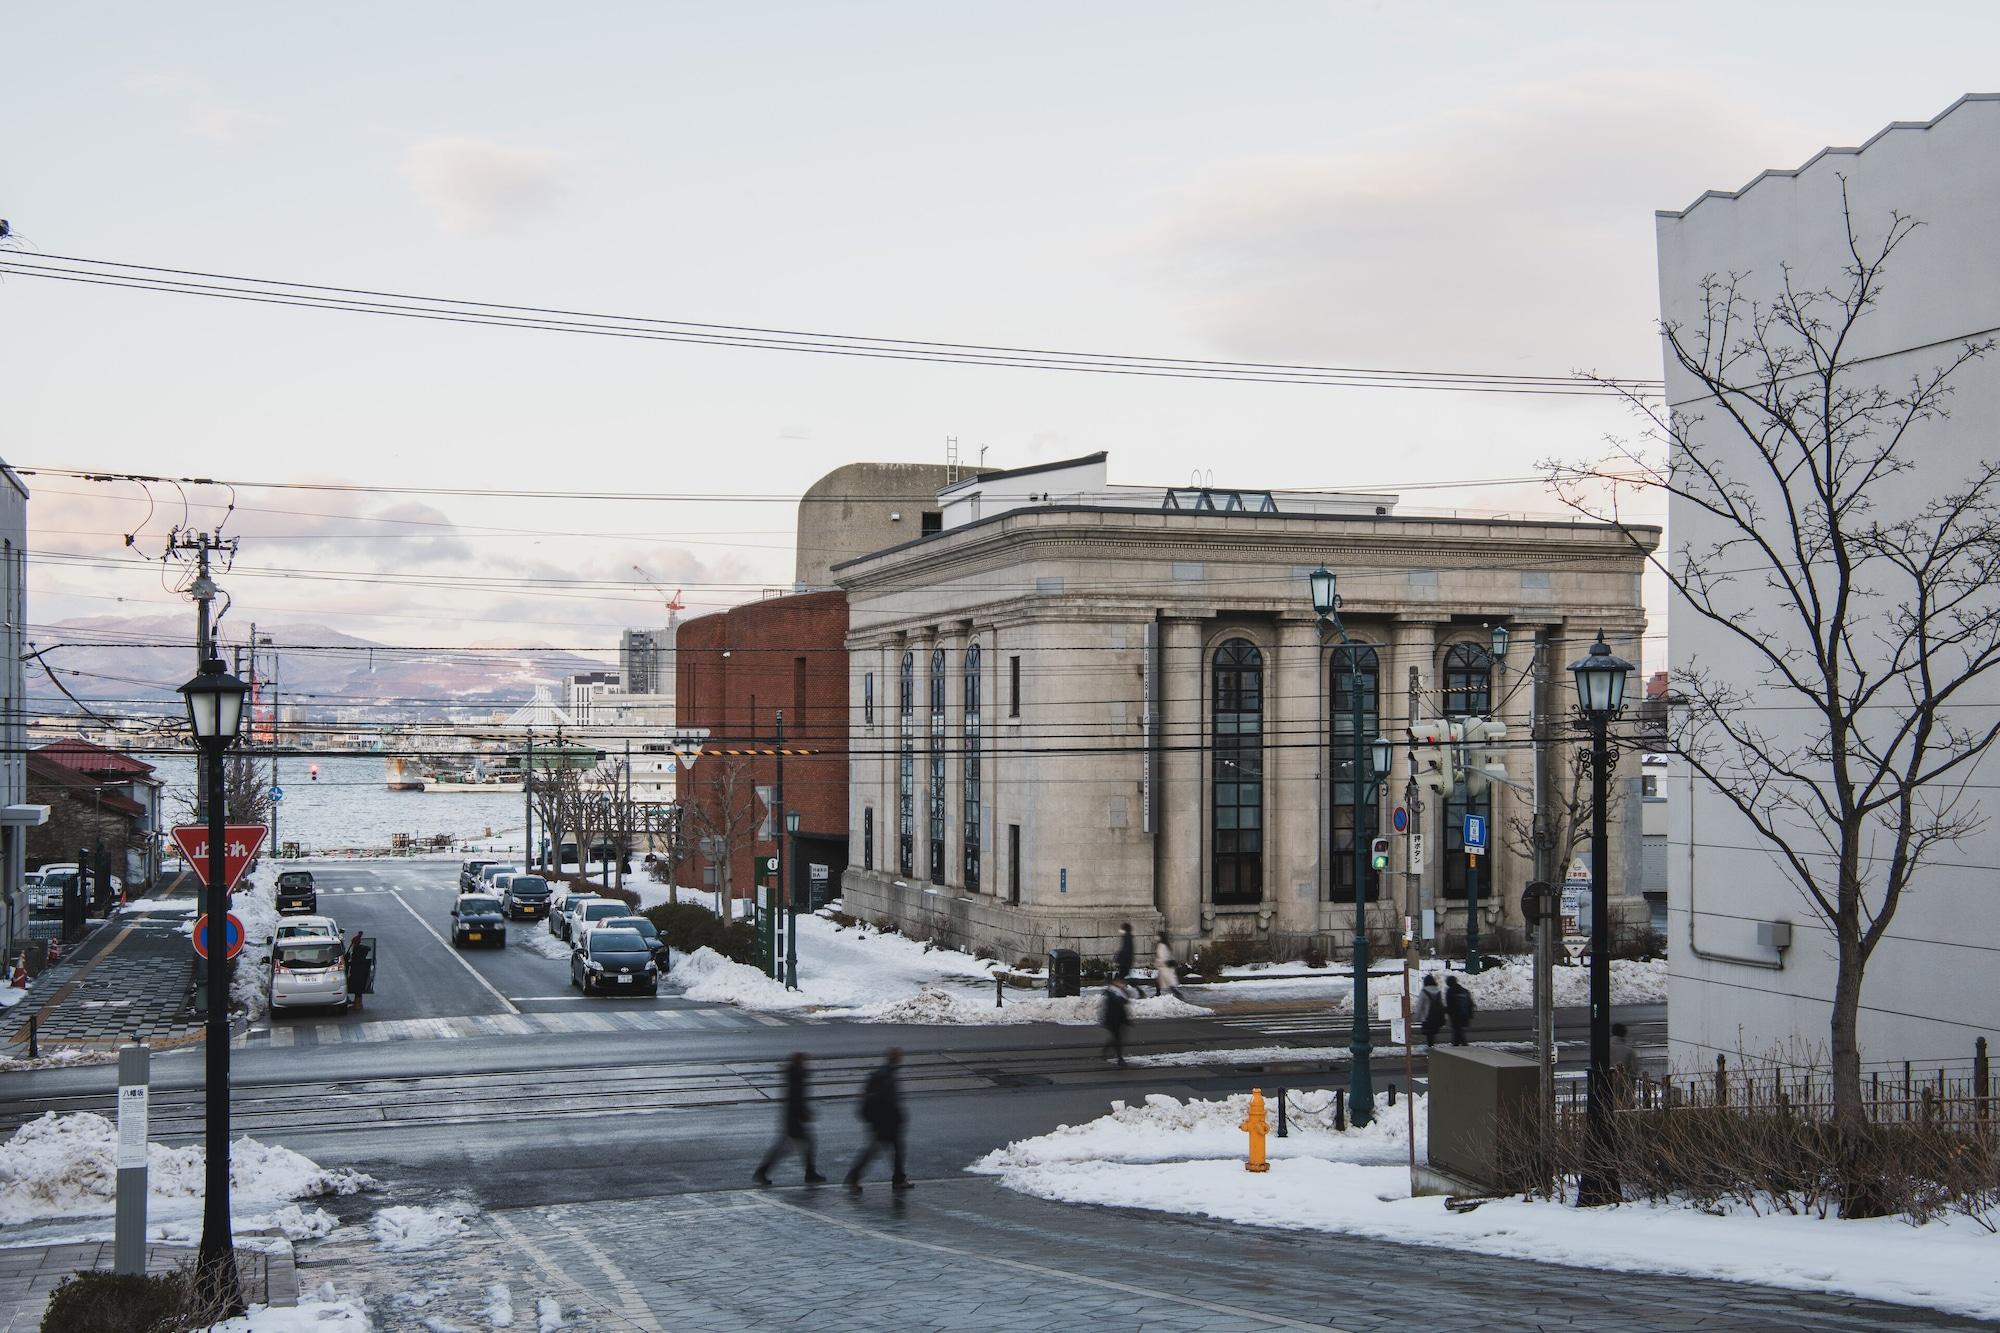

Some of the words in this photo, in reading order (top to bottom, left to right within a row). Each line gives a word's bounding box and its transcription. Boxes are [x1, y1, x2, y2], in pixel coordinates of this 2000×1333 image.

[192, 840, 248, 859] 止れ
[1413, 835, 1421, 864] 押ボタン
[123, 1088, 144, 1097] 八幡坂
